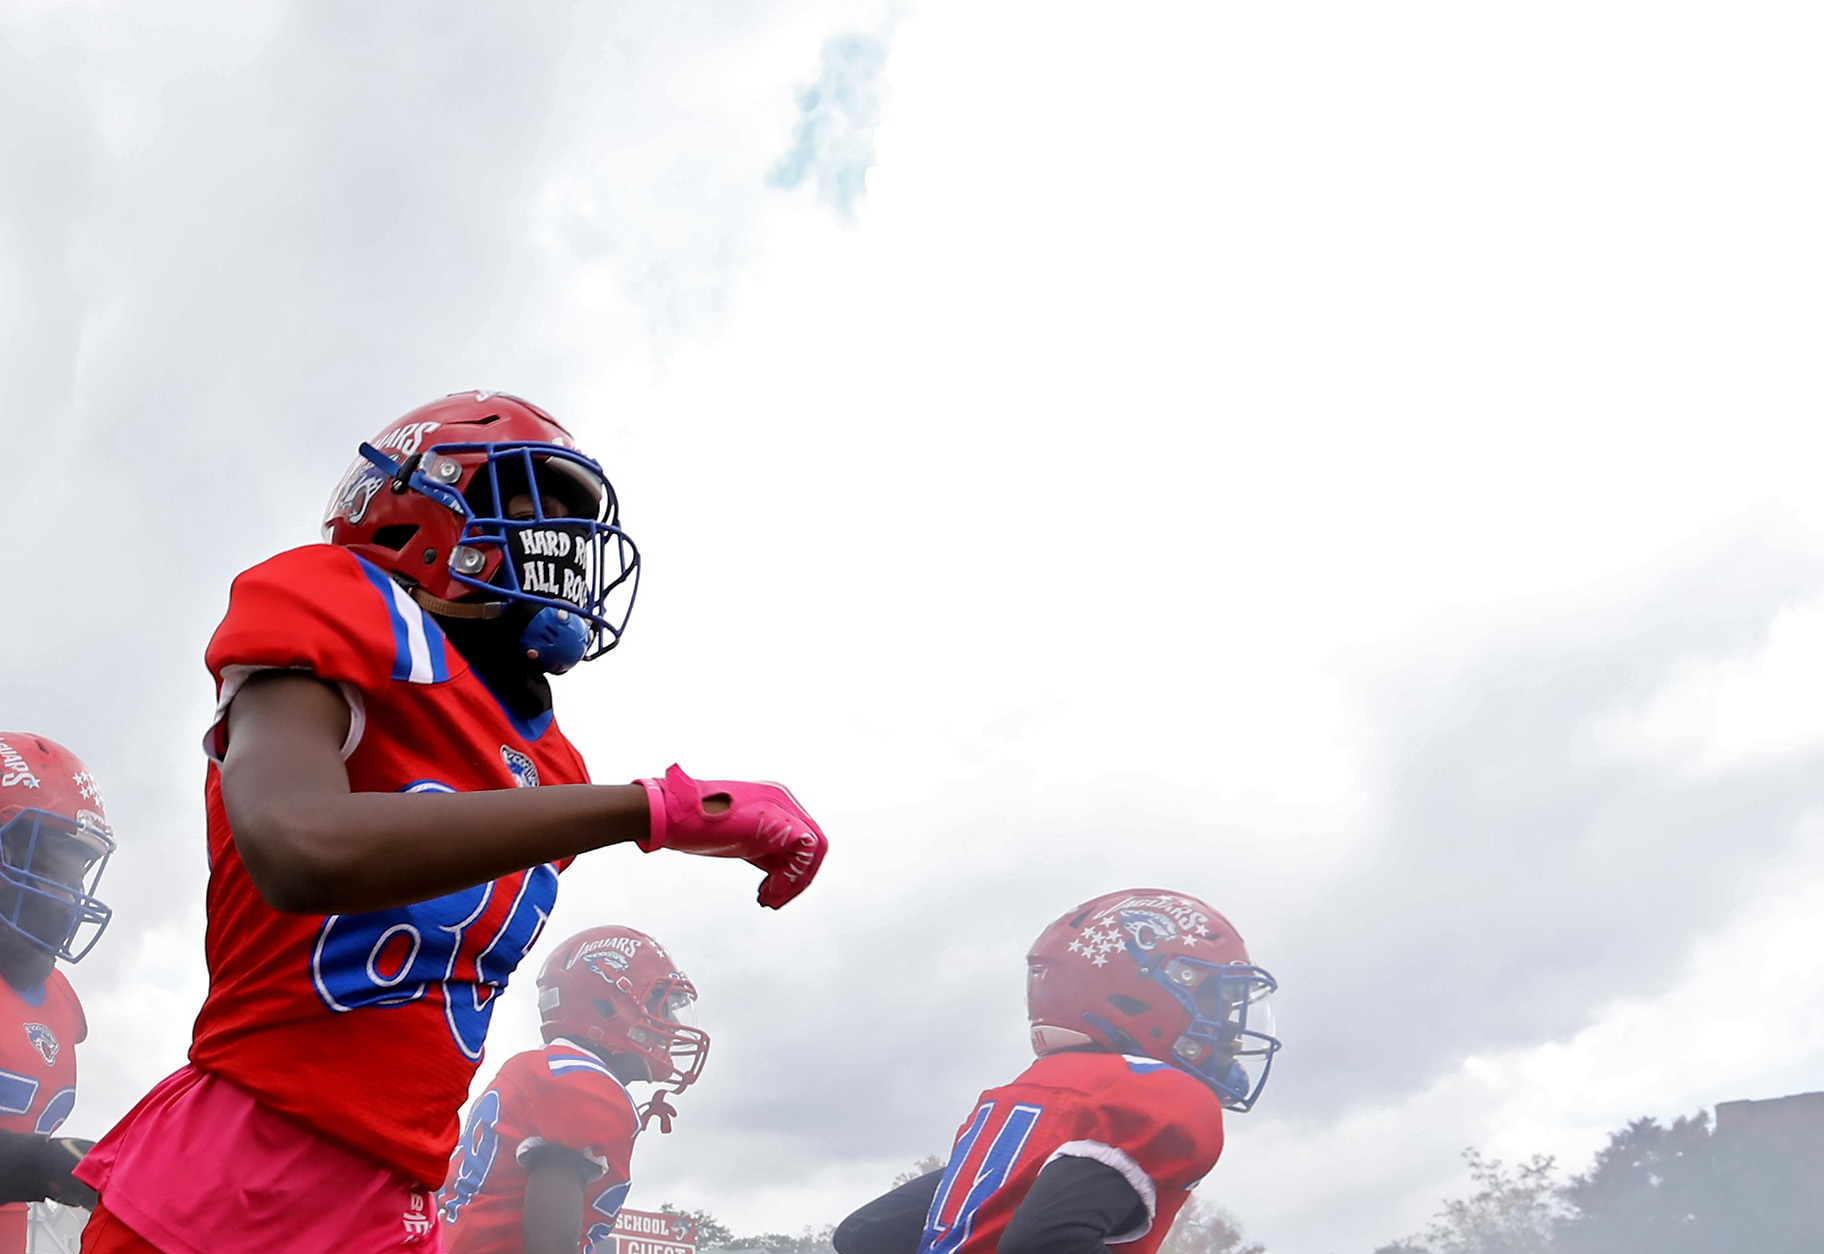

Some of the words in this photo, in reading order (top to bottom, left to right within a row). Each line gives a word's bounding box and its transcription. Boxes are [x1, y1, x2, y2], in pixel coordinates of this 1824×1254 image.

[518, 529, 571, 557] HARD
[522, 560, 559, 595] ALL
[1093, 895, 1209, 931] JAGUARS
[566, 937, 642, 970] JAGUARS
[615, 1213, 669, 1236] SCHOOL
